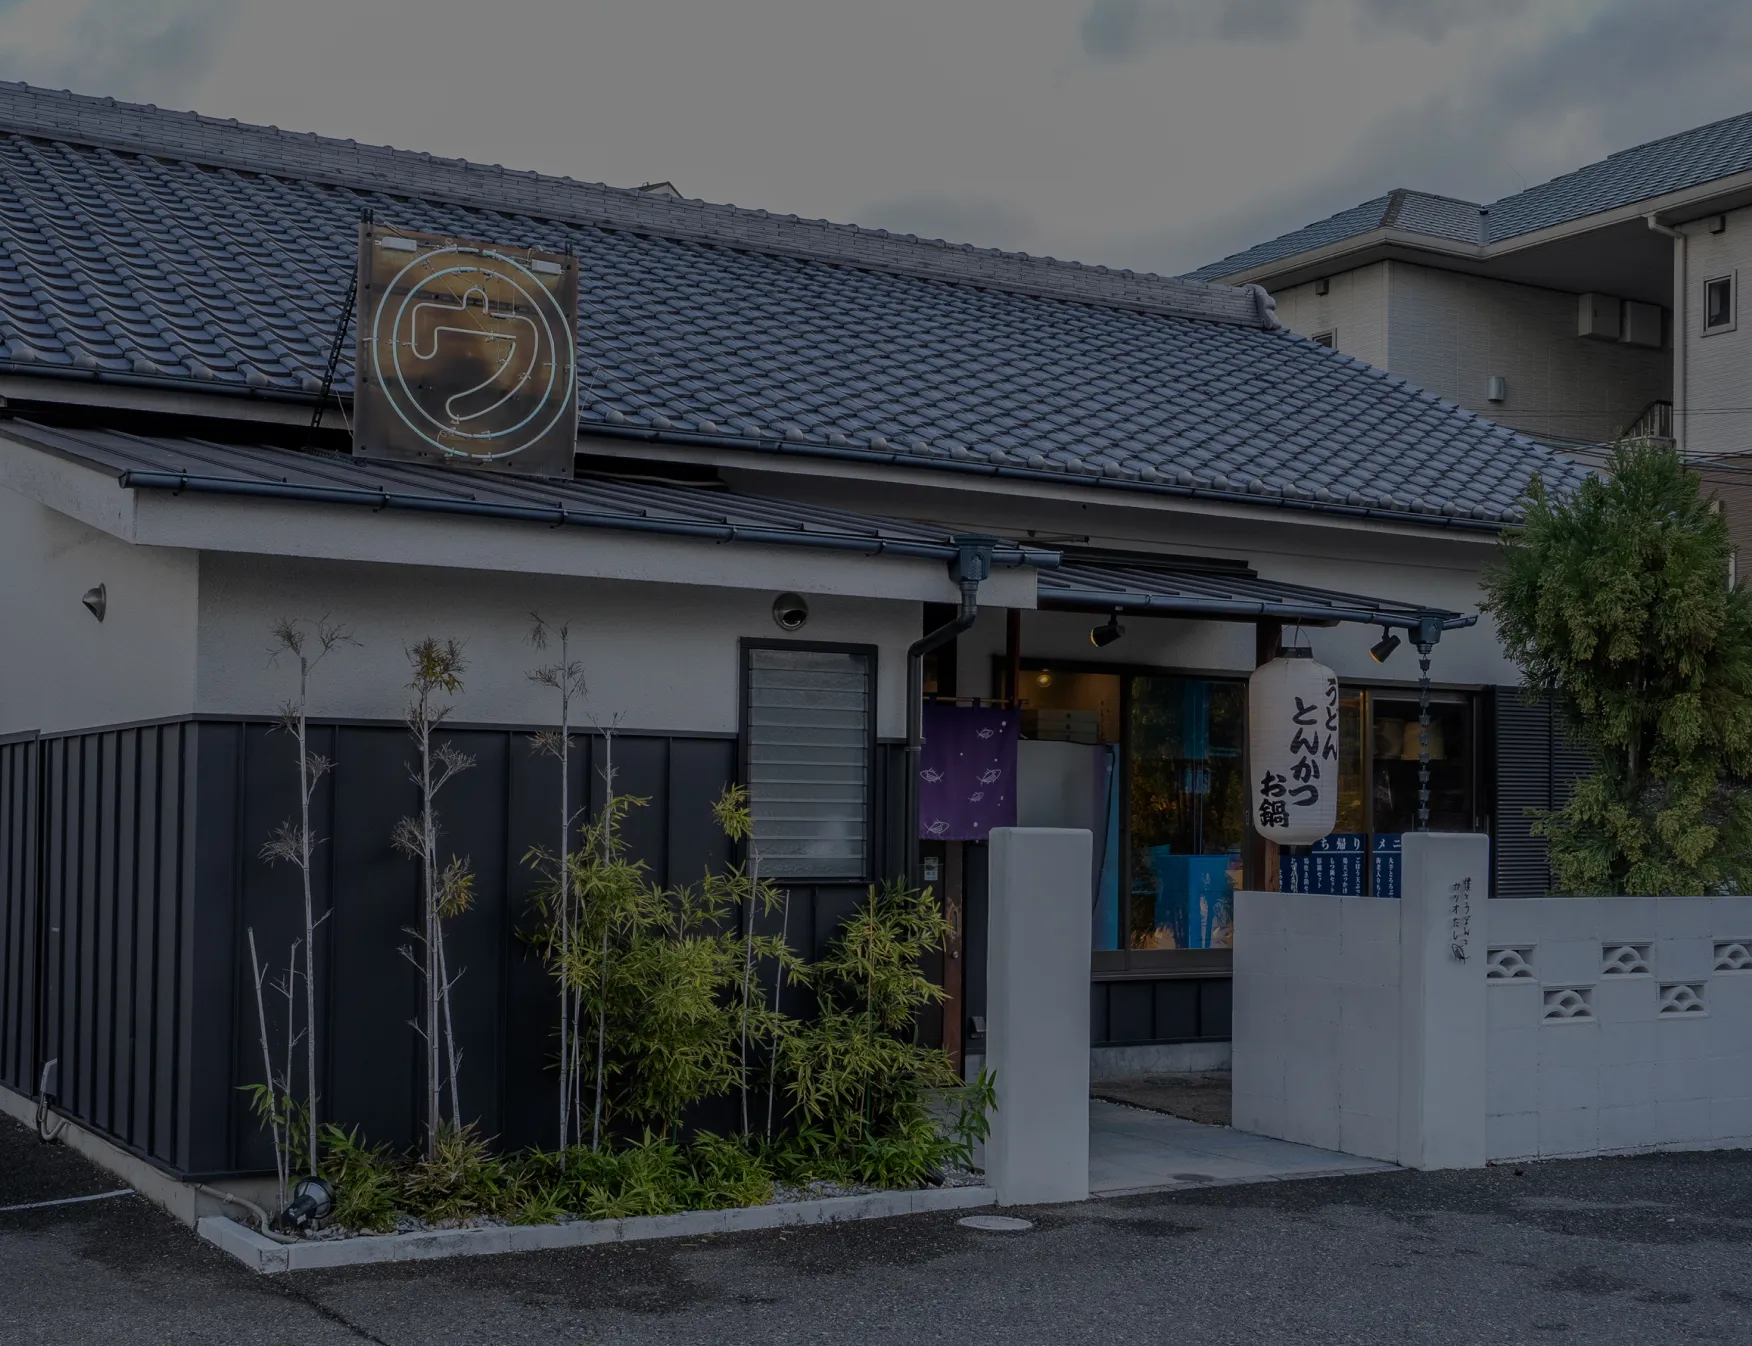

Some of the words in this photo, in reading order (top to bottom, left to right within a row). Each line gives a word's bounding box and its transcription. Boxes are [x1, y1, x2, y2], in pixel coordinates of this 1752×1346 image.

[1288, 696, 1320, 807] とんかつ
[1258, 770, 1290, 828] お鍋
